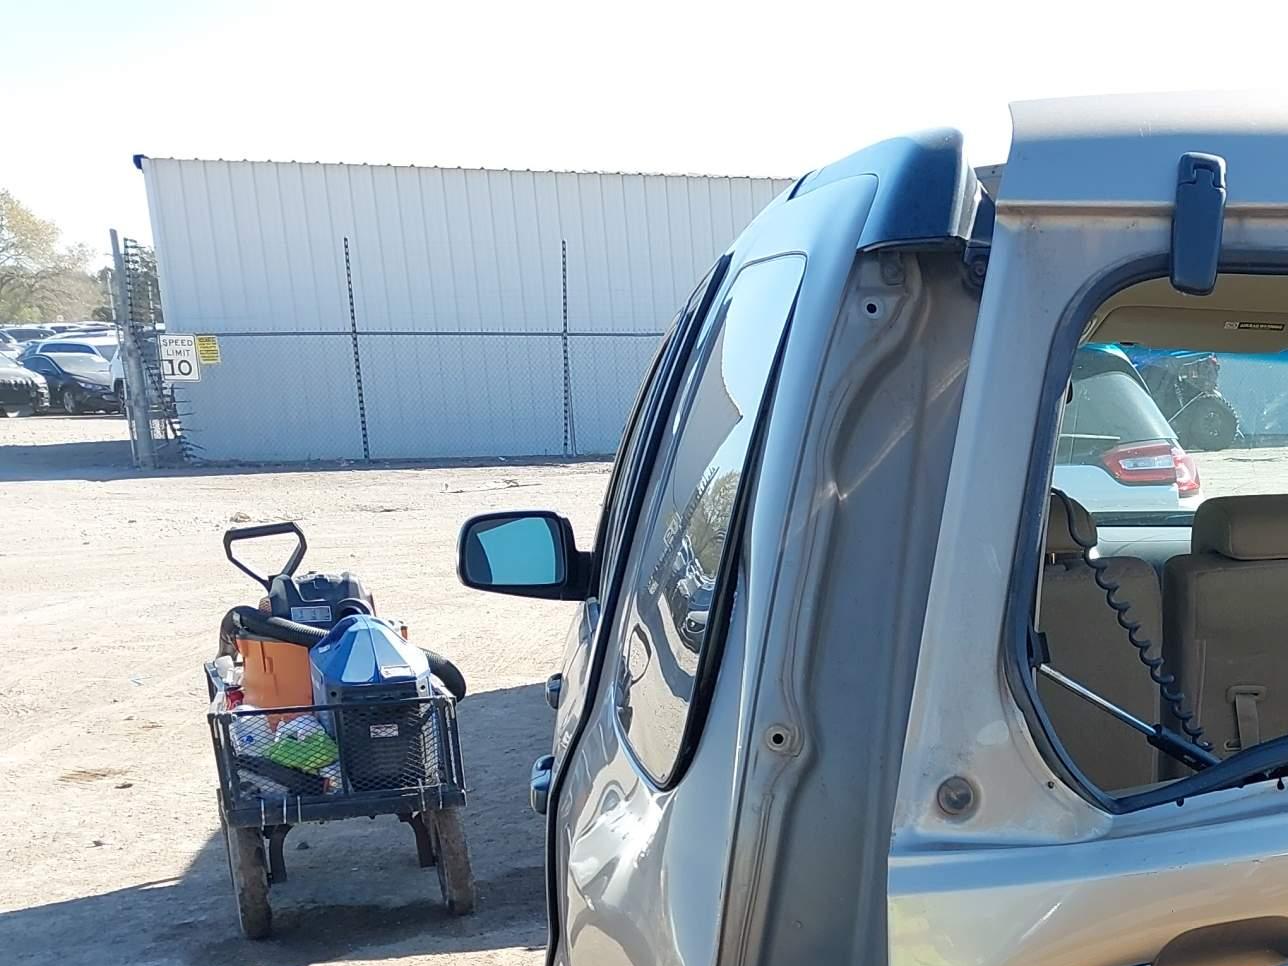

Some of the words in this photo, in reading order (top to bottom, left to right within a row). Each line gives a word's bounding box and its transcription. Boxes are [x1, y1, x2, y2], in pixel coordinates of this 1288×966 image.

[162, 338, 193, 347] SPEED
[166, 349, 191, 357] LIMIT
[165, 359, 193, 376] 10
